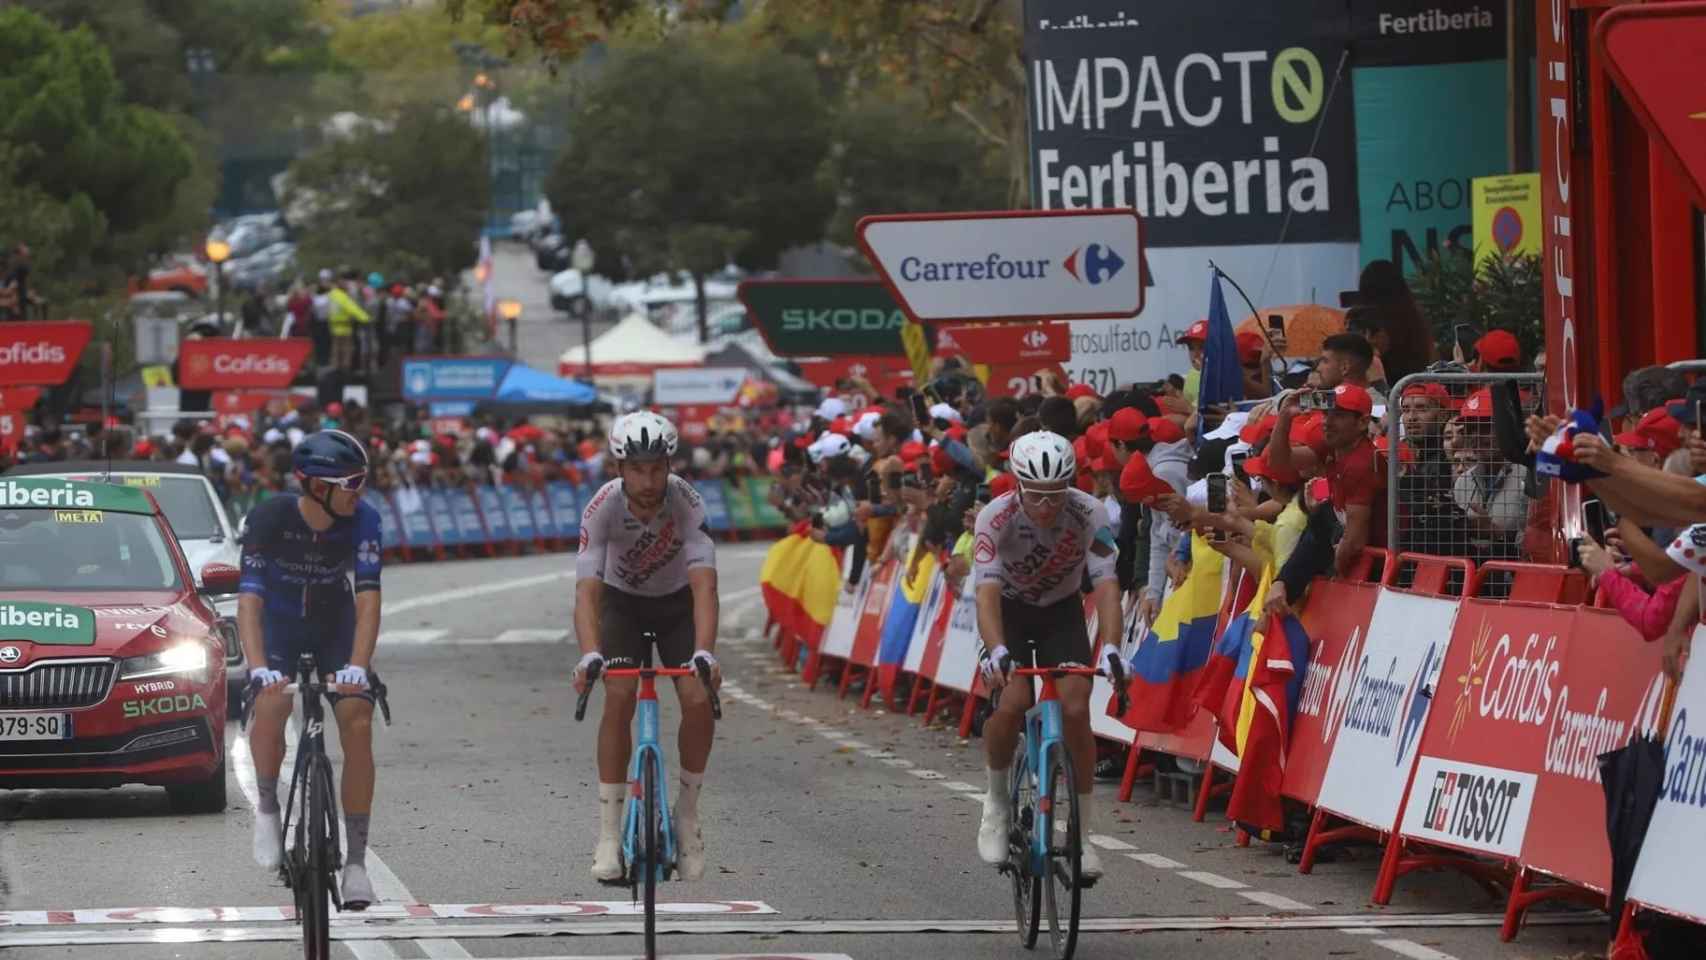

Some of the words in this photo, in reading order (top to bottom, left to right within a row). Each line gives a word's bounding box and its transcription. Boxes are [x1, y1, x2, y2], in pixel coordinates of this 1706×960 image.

[1379, 7, 1493, 34] Fertiberia
[1039, 136, 1330, 217] Fertiberia
[1386, 178, 1472, 212] ABO
[901, 255, 1050, 282] Carrefour
[213, 353, 290, 373] Cofidis
[0, 481, 94, 507] iberia
[58, 511, 99, 523] META
[0, 604, 79, 629] iberia
[134, 680, 175, 694] HYBRID
[1479, 633, 1560, 726] Cofidis
[1344, 655, 1405, 738] Carrefour
[1449, 773, 1521, 845] TISSOT
